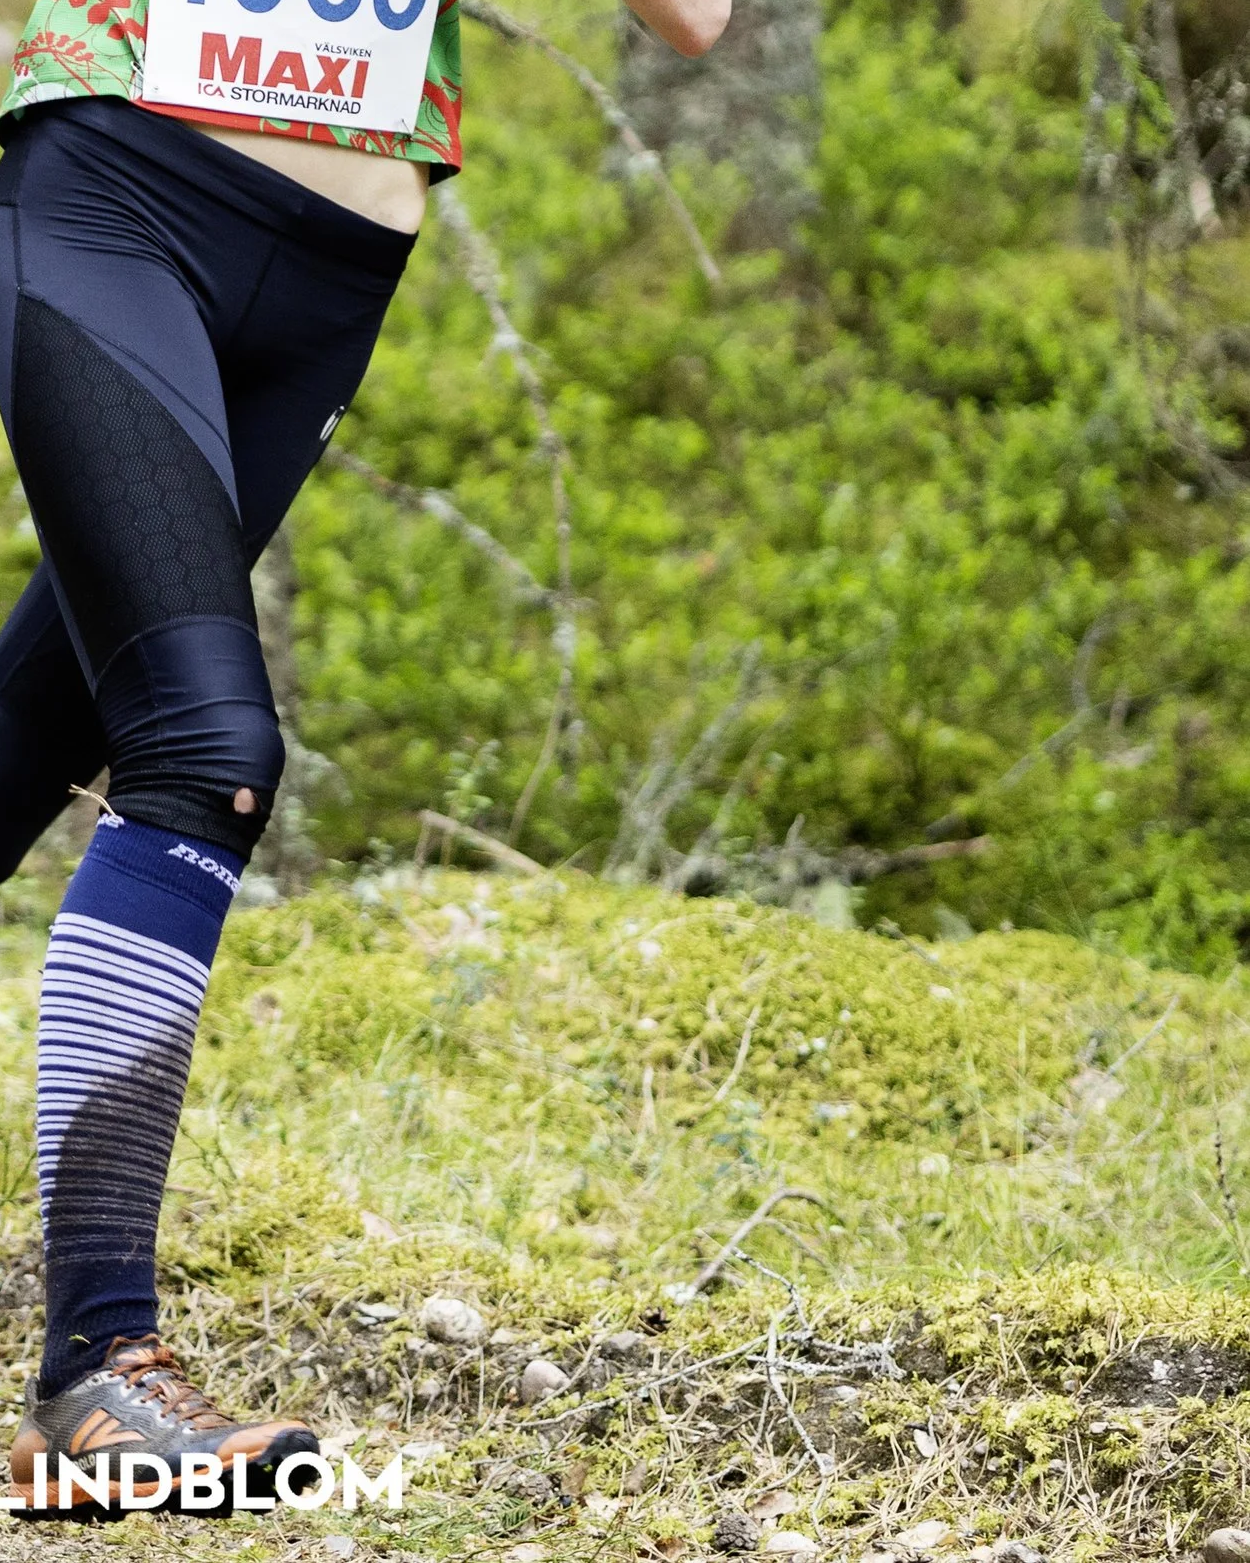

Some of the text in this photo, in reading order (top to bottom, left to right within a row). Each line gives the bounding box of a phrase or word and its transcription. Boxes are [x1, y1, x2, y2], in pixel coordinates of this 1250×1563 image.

[198, 31, 371, 100] MAXI
[315, 42, 373, 58] VÄLSVIKEN
[198, 82, 362, 116] ICA STORMARKNAD
